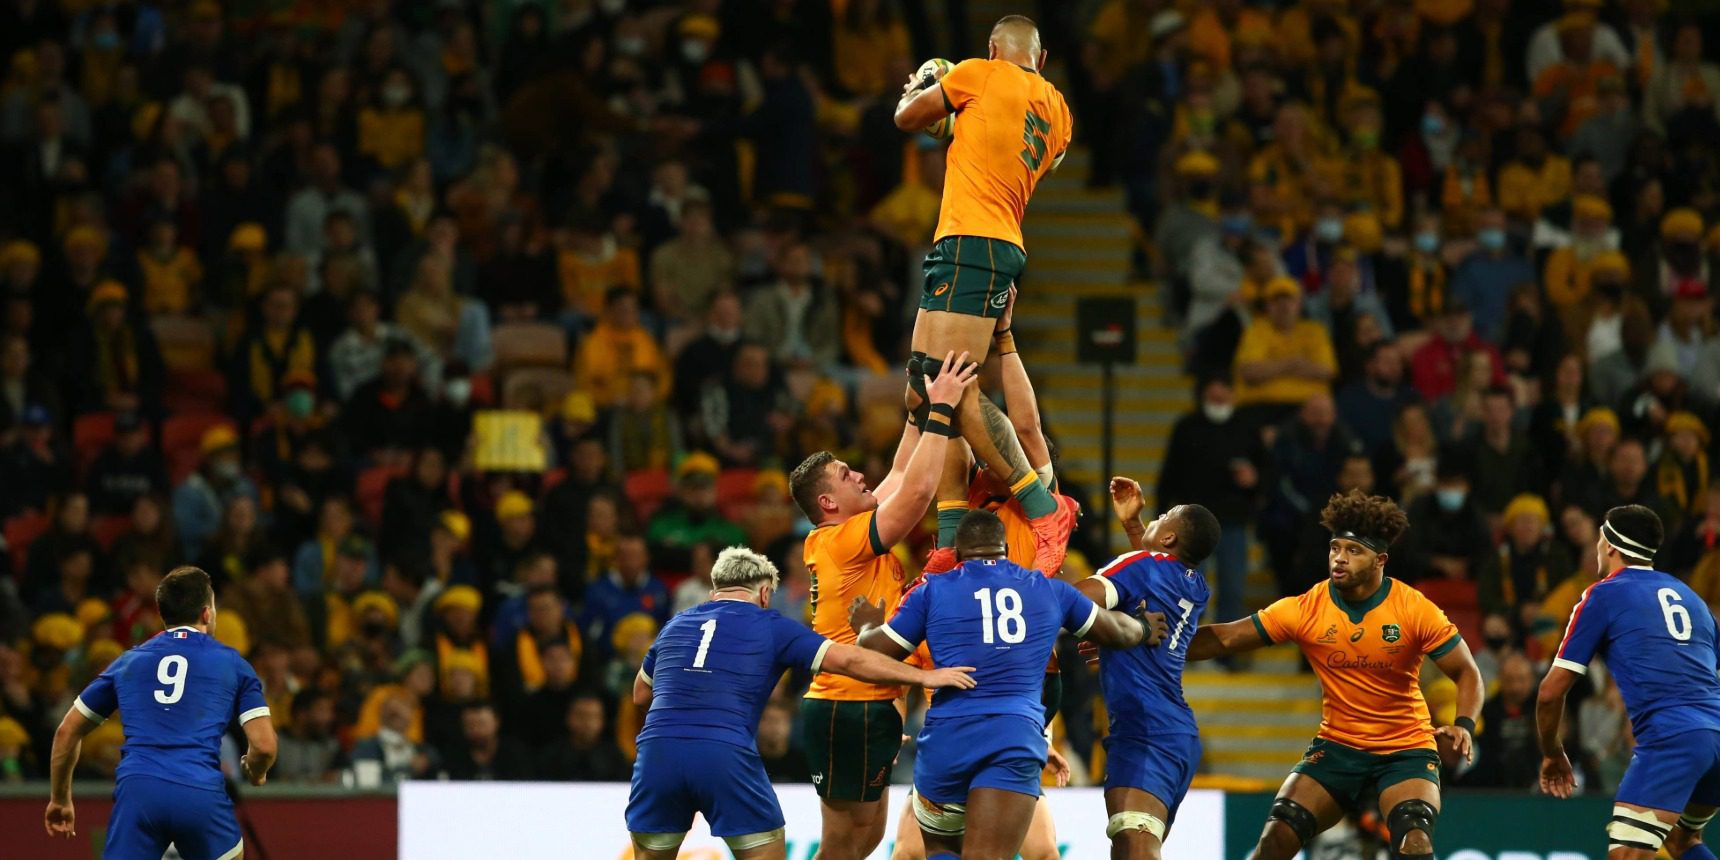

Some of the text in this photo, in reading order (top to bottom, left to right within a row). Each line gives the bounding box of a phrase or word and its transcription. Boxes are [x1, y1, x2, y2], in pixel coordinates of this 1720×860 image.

[1021, 111, 1050, 171] 5
[974, 588, 1027, 644] 18
[1169, 598, 1194, 651] 7
[1658, 588, 1692, 640] 6
[693, 619, 716, 668] 1
[1327, 650, 1393, 671] Cadbury
[154, 655, 188, 704] 9
